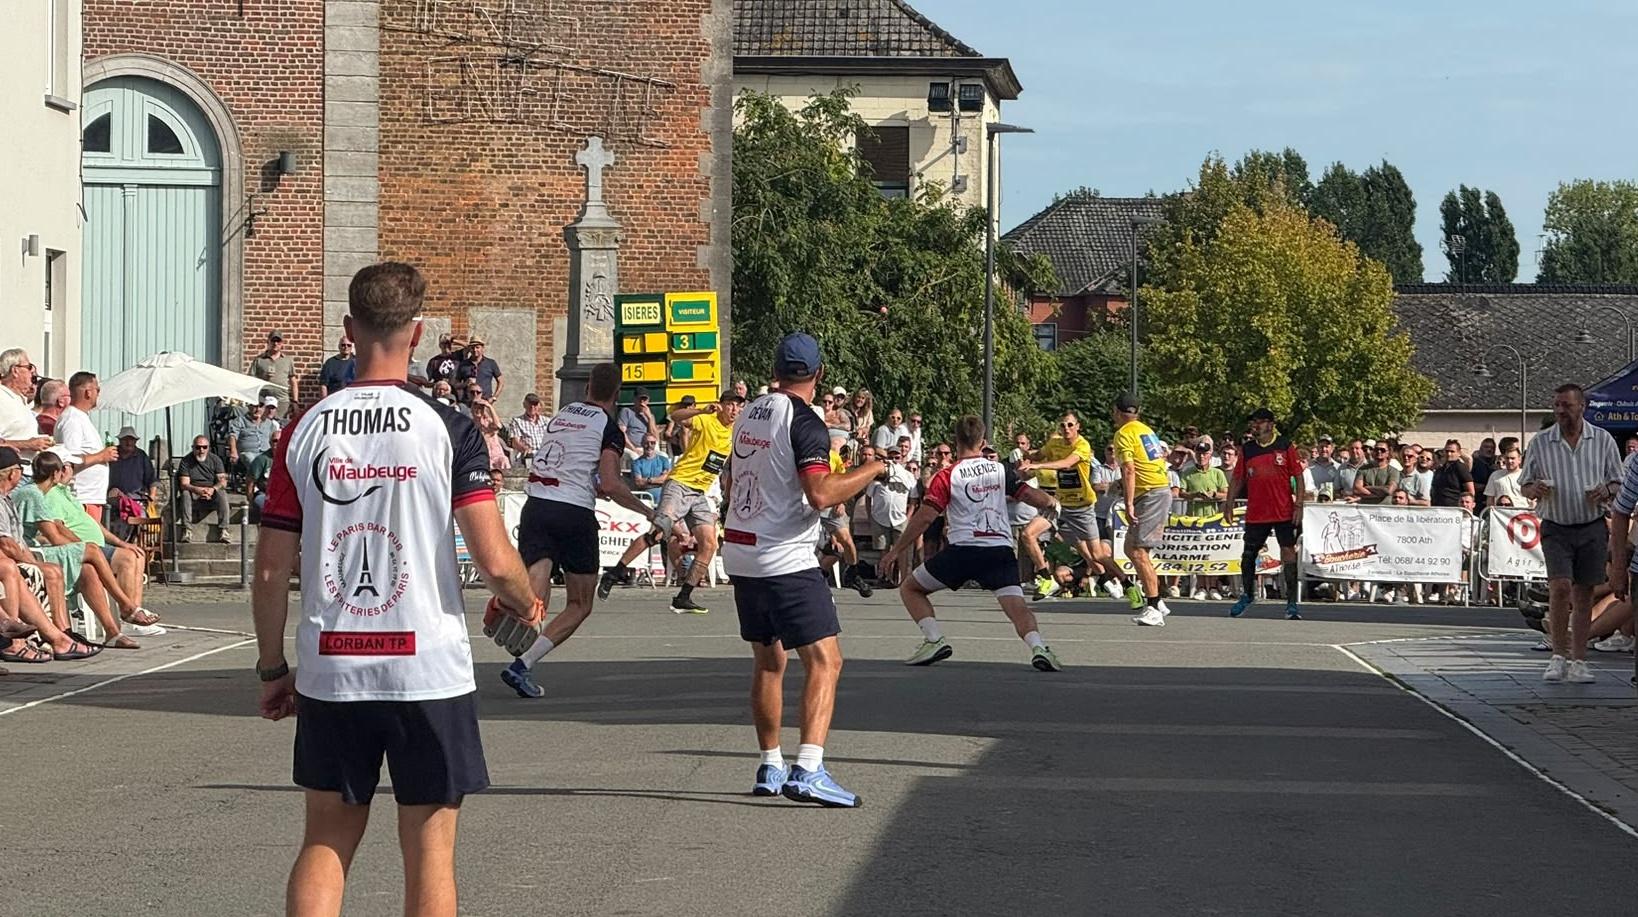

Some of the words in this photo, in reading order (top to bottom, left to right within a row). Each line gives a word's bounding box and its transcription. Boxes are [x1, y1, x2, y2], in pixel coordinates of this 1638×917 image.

[624, 306, 659, 320] ISIERES
[630, 336, 639, 350] 7
[679, 335, 689, 349] 3
[625, 365, 643, 378] 15
[320, 406, 412, 436] THOMAS
[1608, 412, 1622, 420] Ath
[329, 464, 417, 484] Maubeuge
[959, 463, 997, 479] MAXENCE
[1369, 514, 1392, 523] Place
[1393, 515, 1404, 523] de
[1406, 515, 1414, 523] la
[1416, 515, 1453, 524] libération
[1455, 516, 1461, 524] 8
[599, 520, 641, 533] CKX
[328, 539, 339, 552] LE
[336, 522, 365, 541] PARIS
[367, 522, 387, 535] BAR
[387, 531, 403, 552] PUB
[600, 535, 635, 547] GHIE
[1205, 533, 1242, 541] GENE
[1397, 536, 1417, 544] 7800
[1418, 536, 1433, 544] Ath
[1123, 562, 1229, 572] 0/84.12.52
[1415, 557, 1426, 565] 44
[1427, 557, 1439, 566] 92
[1440, 557, 1451, 566] 90
[324, 574, 337, 594] LES
[333, 592, 381, 617] FRITERIES
[381, 600, 394, 613] DE
[391, 573, 409, 604] PARIS
[325, 637, 384, 650] LORBAN
[389, 637, 407, 649] TP
